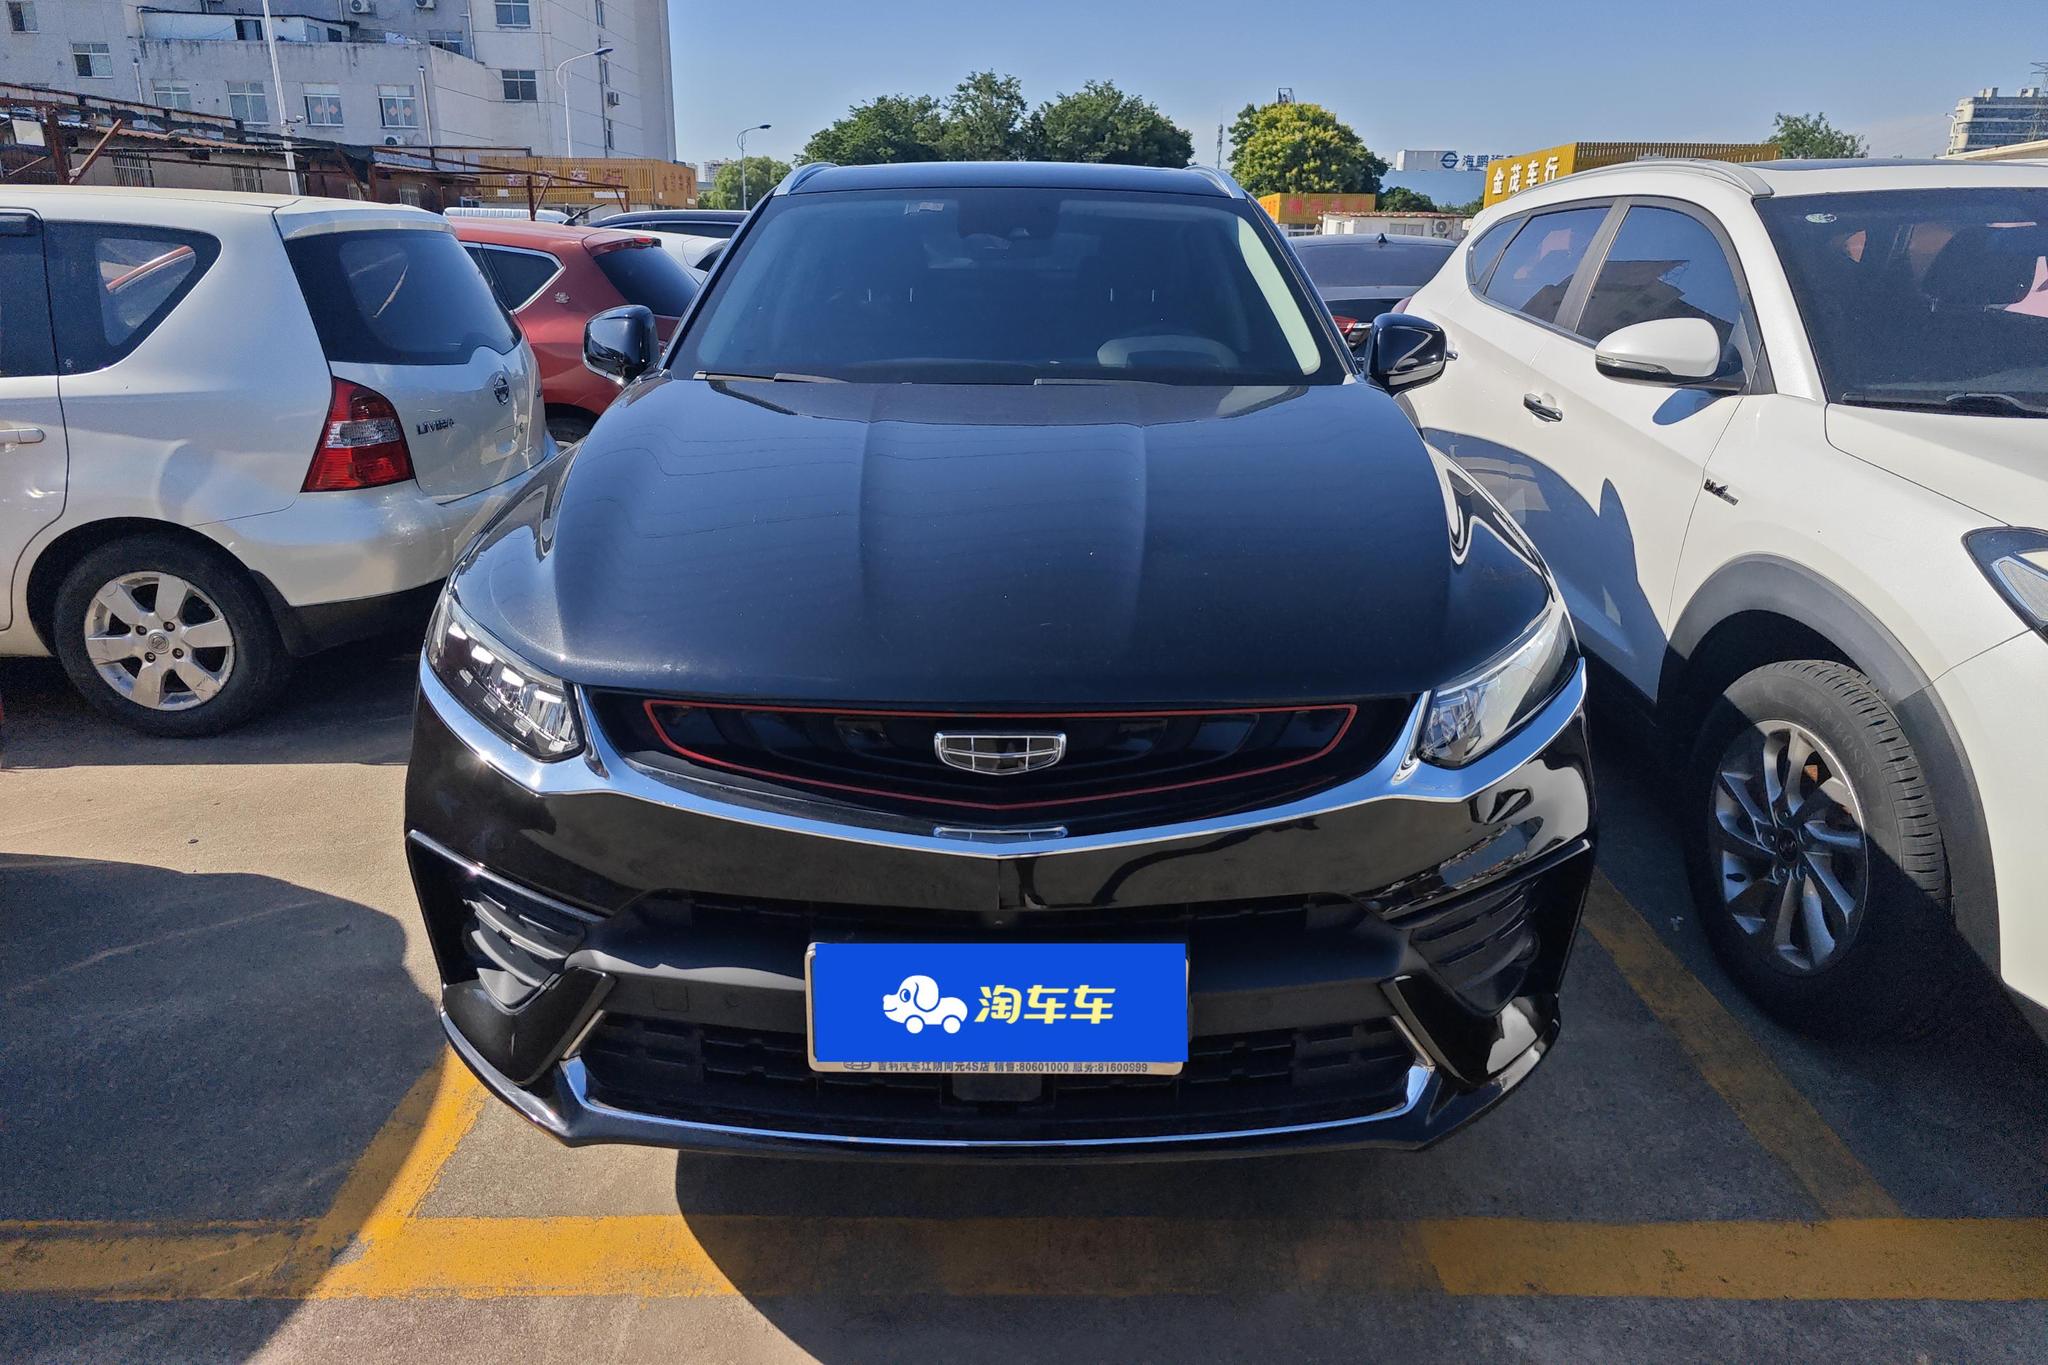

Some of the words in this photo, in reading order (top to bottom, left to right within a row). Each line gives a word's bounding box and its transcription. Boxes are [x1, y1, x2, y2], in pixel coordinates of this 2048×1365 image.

[1462, 154, 1513, 168] 海鹏
[1492, 156, 1559, 195] 金茂车行
